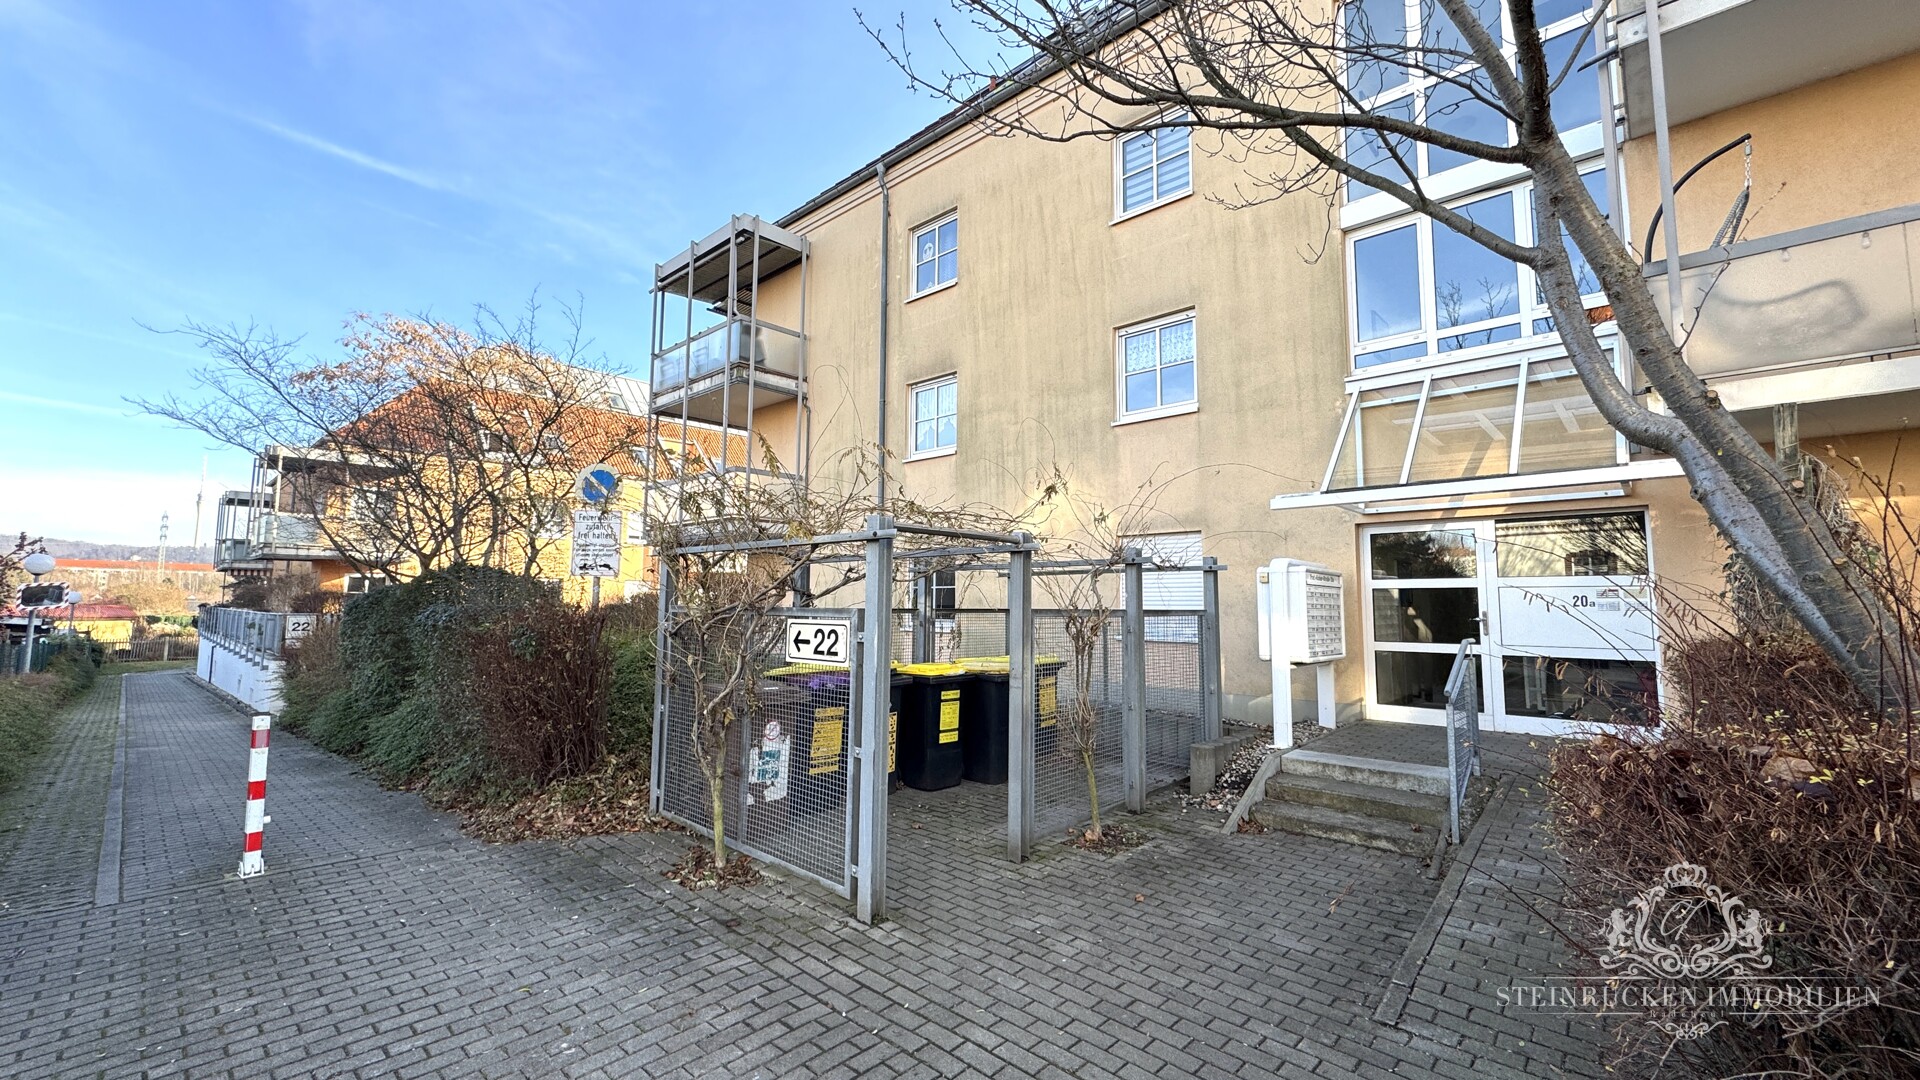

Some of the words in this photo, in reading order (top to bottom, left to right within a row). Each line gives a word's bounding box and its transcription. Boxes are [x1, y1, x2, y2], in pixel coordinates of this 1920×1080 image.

[578, 532, 590, 540] frei
[1572, 595, 1596, 608] 20a
[291, 621, 310, 631] 22
[813, 628, 839, 656] 22
